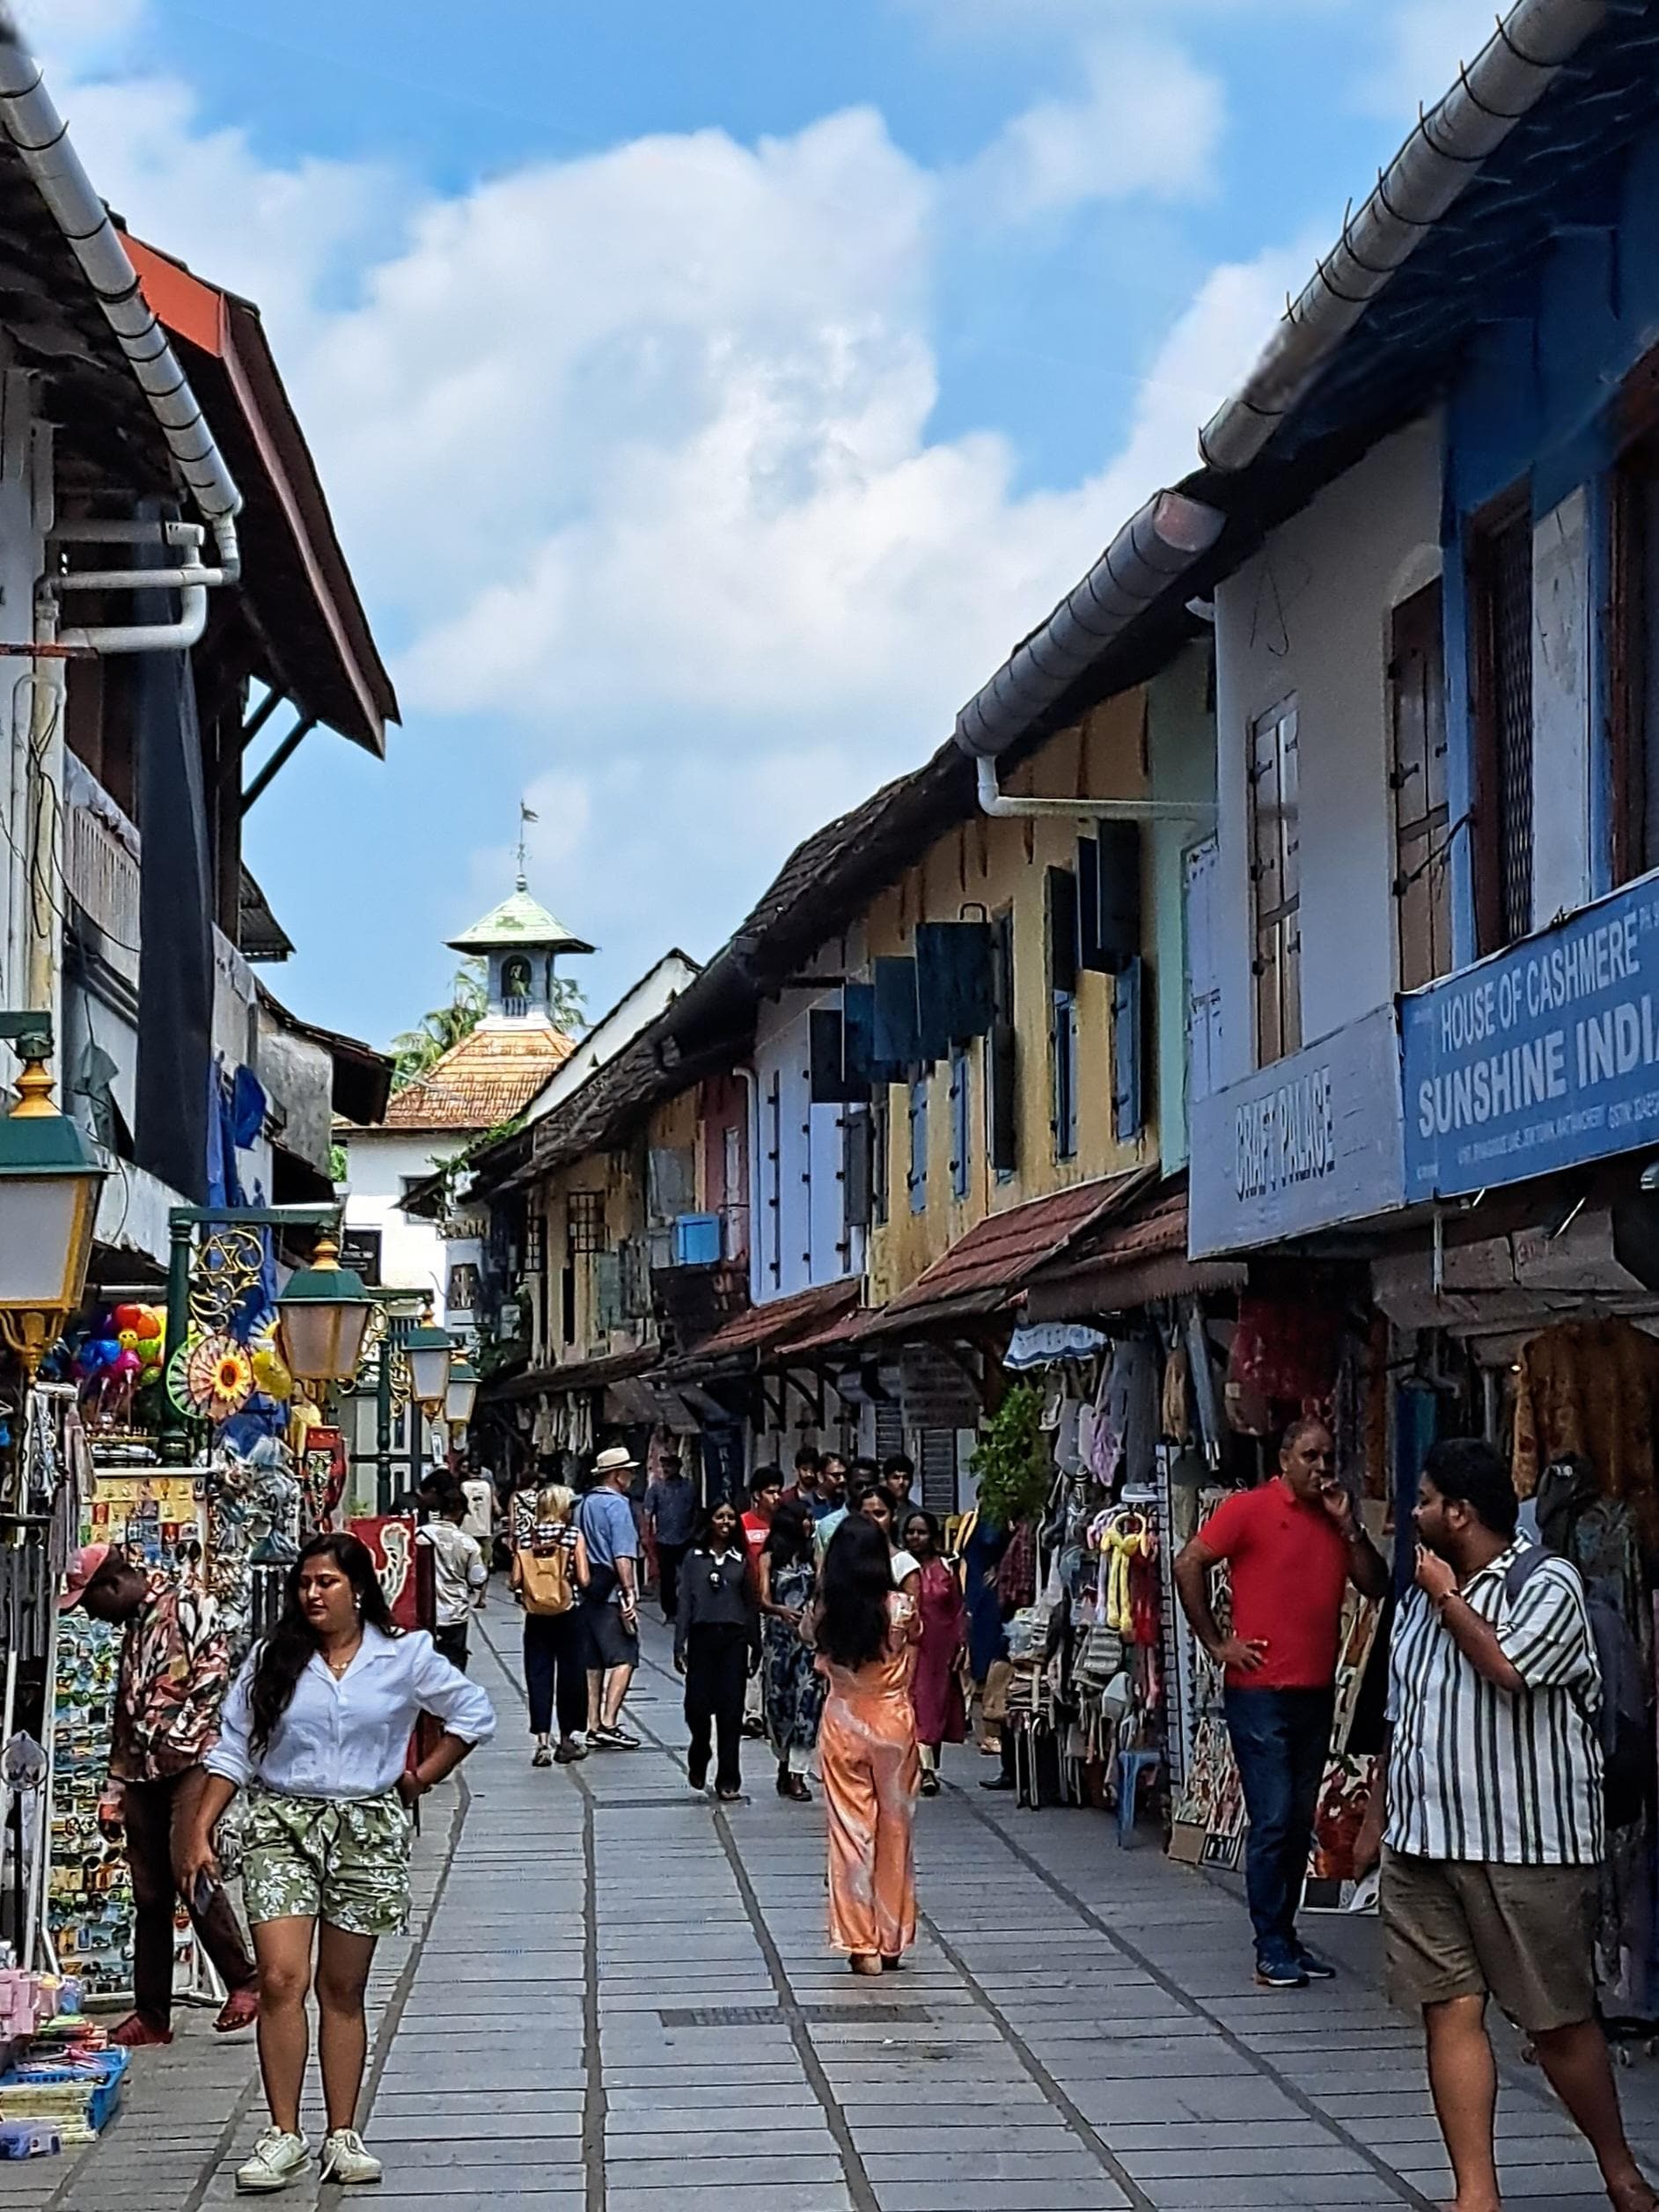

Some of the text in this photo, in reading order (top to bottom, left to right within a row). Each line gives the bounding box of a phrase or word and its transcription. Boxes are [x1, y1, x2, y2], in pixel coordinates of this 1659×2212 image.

[1441, 981, 1495, 1053] HOUSE
[1499, 967, 1523, 1029] OF
[1526, 911, 1641, 1018] CASHMERE
[1236, 1092, 1276, 1202] CRAFT
[1277, 1065, 1335, 1187] PALACE
[1418, 1030, 1568, 1138] SUNSHINE
